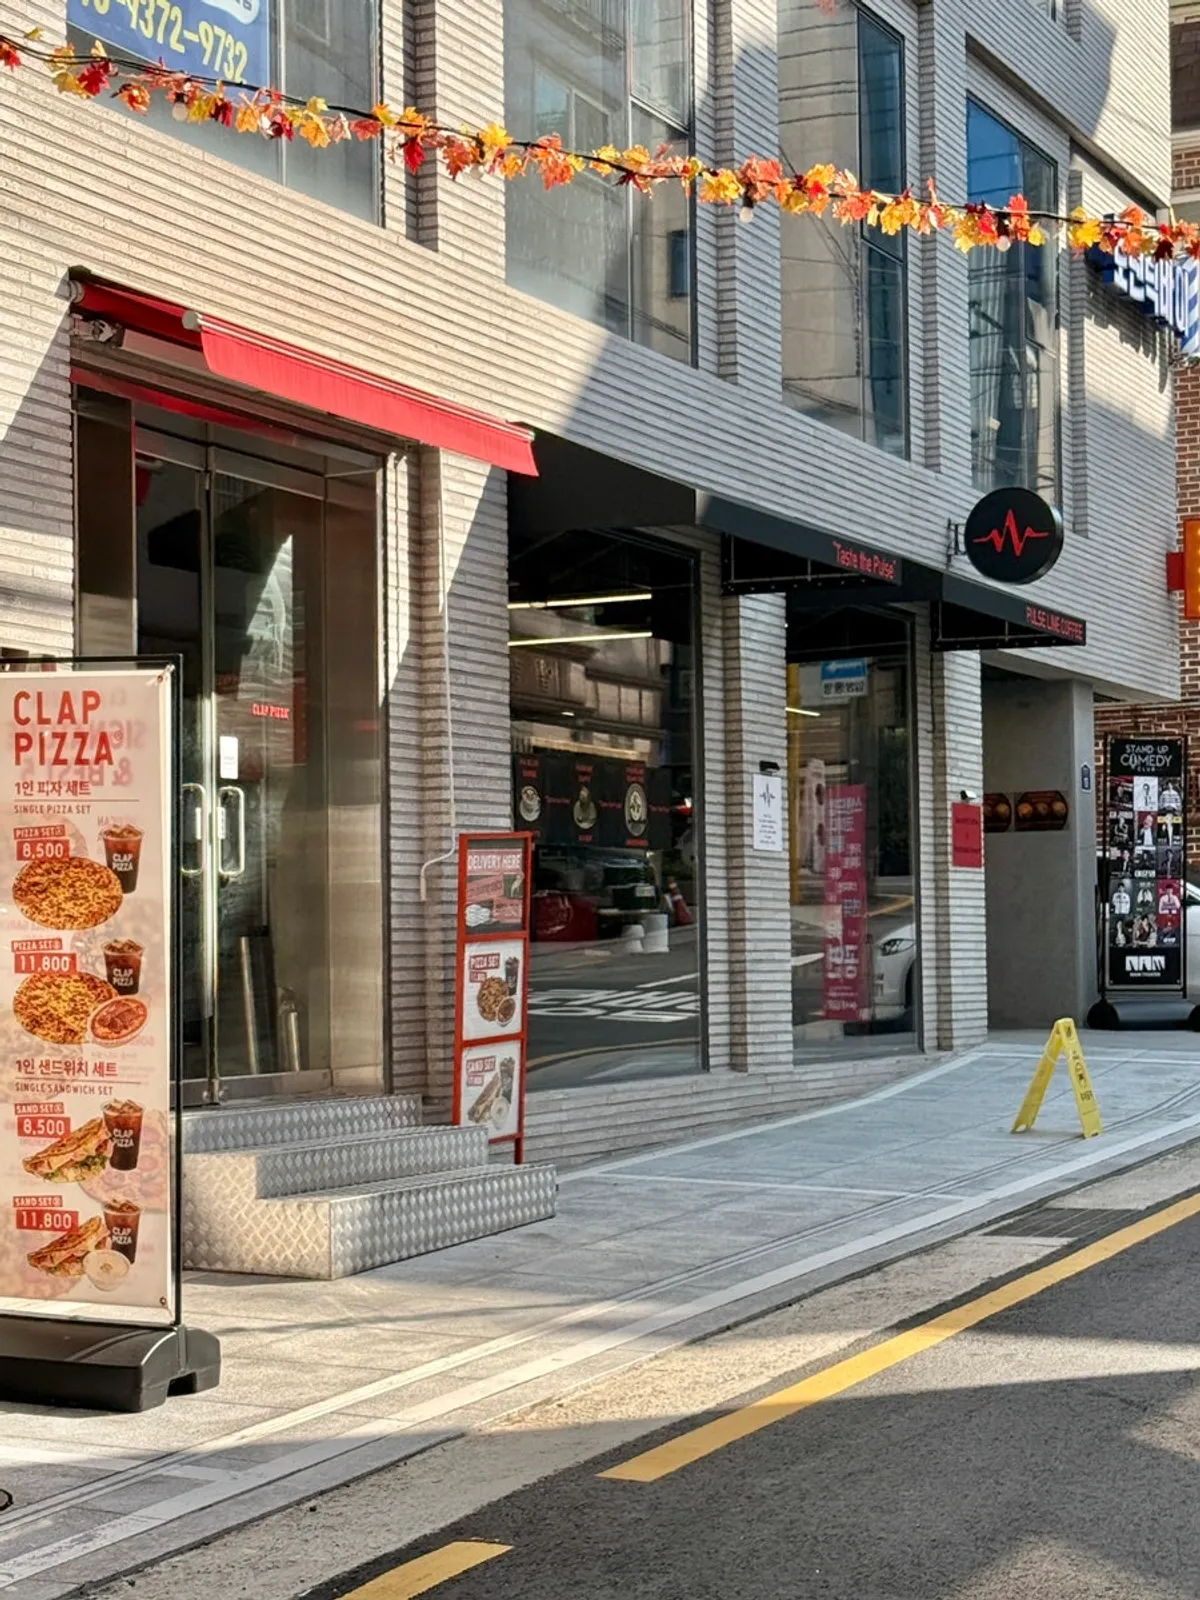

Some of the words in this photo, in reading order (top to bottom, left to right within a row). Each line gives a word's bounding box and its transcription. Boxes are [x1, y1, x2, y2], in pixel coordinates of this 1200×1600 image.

[13, 690, 101, 726] CLAP
[14, 731, 114, 766] PIZZA
[1125, 744, 1154, 754] STAND
[1157, 745, 1169, 754] UP
[1120, 753, 1173, 769] COMEDY
[14, 781, 34, 796] 1인
[37, 780, 62, 797] 피자
[66, 780, 91, 797] 세트
[14, 804, 44, 815] SINGLE
[46, 804, 73, 814] PIZZA
[76, 804, 91, 814] SET
[15, 828, 39, 839] PIZZA
[112, 854, 134, 863] CLAP
[467, 855, 500, 870] DELIVERY
[502, 854, 521, 869] HERE
[112, 862, 134, 872] PIZZA
[13, 941, 37, 951] PIZZA
[113, 968, 134, 977] CLAP
[112, 977, 134, 986] PIZZA
[15, 1059, 35, 1075] 1인
[39, 1059, 88, 1077] 샌드위치
[93, 1062, 118, 1078] 세트
[15, 1083, 46, 1093] SINGLE
[48, 1084, 95, 1096] SANDWICH
[98, 1086, 114, 1096] SET
[16, 1104, 38, 1113] SAND
[112, 1129, 134, 1139] CLAP
[112, 1138, 135, 1148] PIZZA
[15, 1197, 37, 1207] SAND
[112, 1227, 132, 1236] CLAP
[112, 1235, 133, 1245] PIZZA
